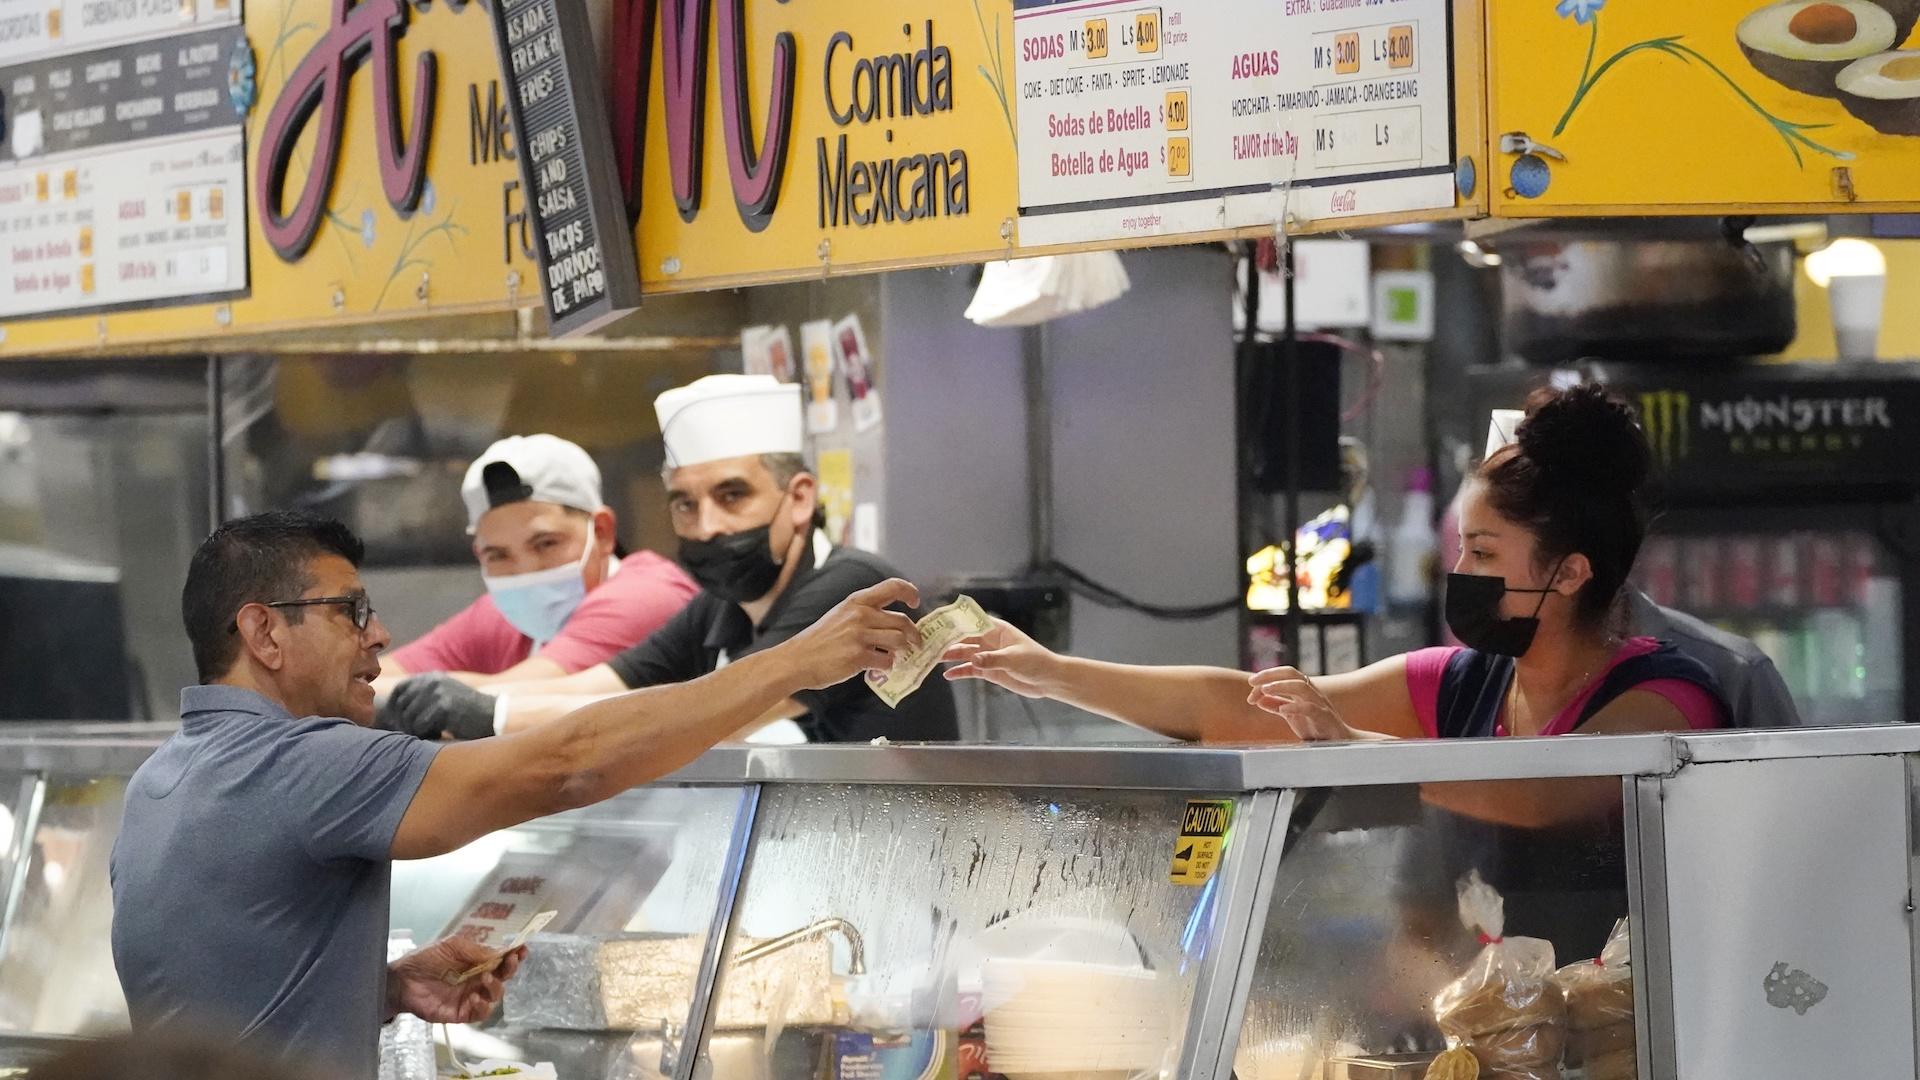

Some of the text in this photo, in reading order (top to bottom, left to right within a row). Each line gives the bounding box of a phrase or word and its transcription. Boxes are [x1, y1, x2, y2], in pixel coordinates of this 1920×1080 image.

[1168, 12, 1181, 26] refill
[1023, 34, 1064, 62] SODAS
[1070, 30, 1078, 51] M
[1173, 31, 1188, 47] price
[824, 19, 953, 126] Comida
[1232, 50, 1279, 80] AGUAS
[1314, 47, 1323, 69] M
[520, 69, 555, 107] FRIES
[1024, 62, 1189, 99] COKE DIET COKE FANTA SPRITE LEMONADE
[1232, 79, 1418, 117] HORCHATA TAMARINDO JAMAICA ORANGE BANG
[1049, 113, 1084, 138] Sodas
[1089, 110, 1103, 134] de
[1107, 105, 1151, 133] Botella
[530, 126, 567, 162] CHIPS
[1233, 133, 1261, 160] FLAVOR
[1262, 132, 1270, 158] of
[1271, 131, 1283, 156] the
[1285, 130, 1298, 161] Day
[1316, 129, 1325, 151] M
[541, 158, 567, 190] AND
[1052, 151, 1094, 177] Botella
[1100, 149, 1113, 173] de
[1118, 147, 1148, 177] Agua
[816, 129, 970, 229] Mexicana
[538, 187, 577, 218] SALSA
[1122, 213, 1161, 231] enjoy together
[545, 220, 584, 260] TACOS
[552, 287, 570, 314] DE
[1701, 395, 1890, 432] MONSTER
[1184, 806, 1227, 833] CAUTION
